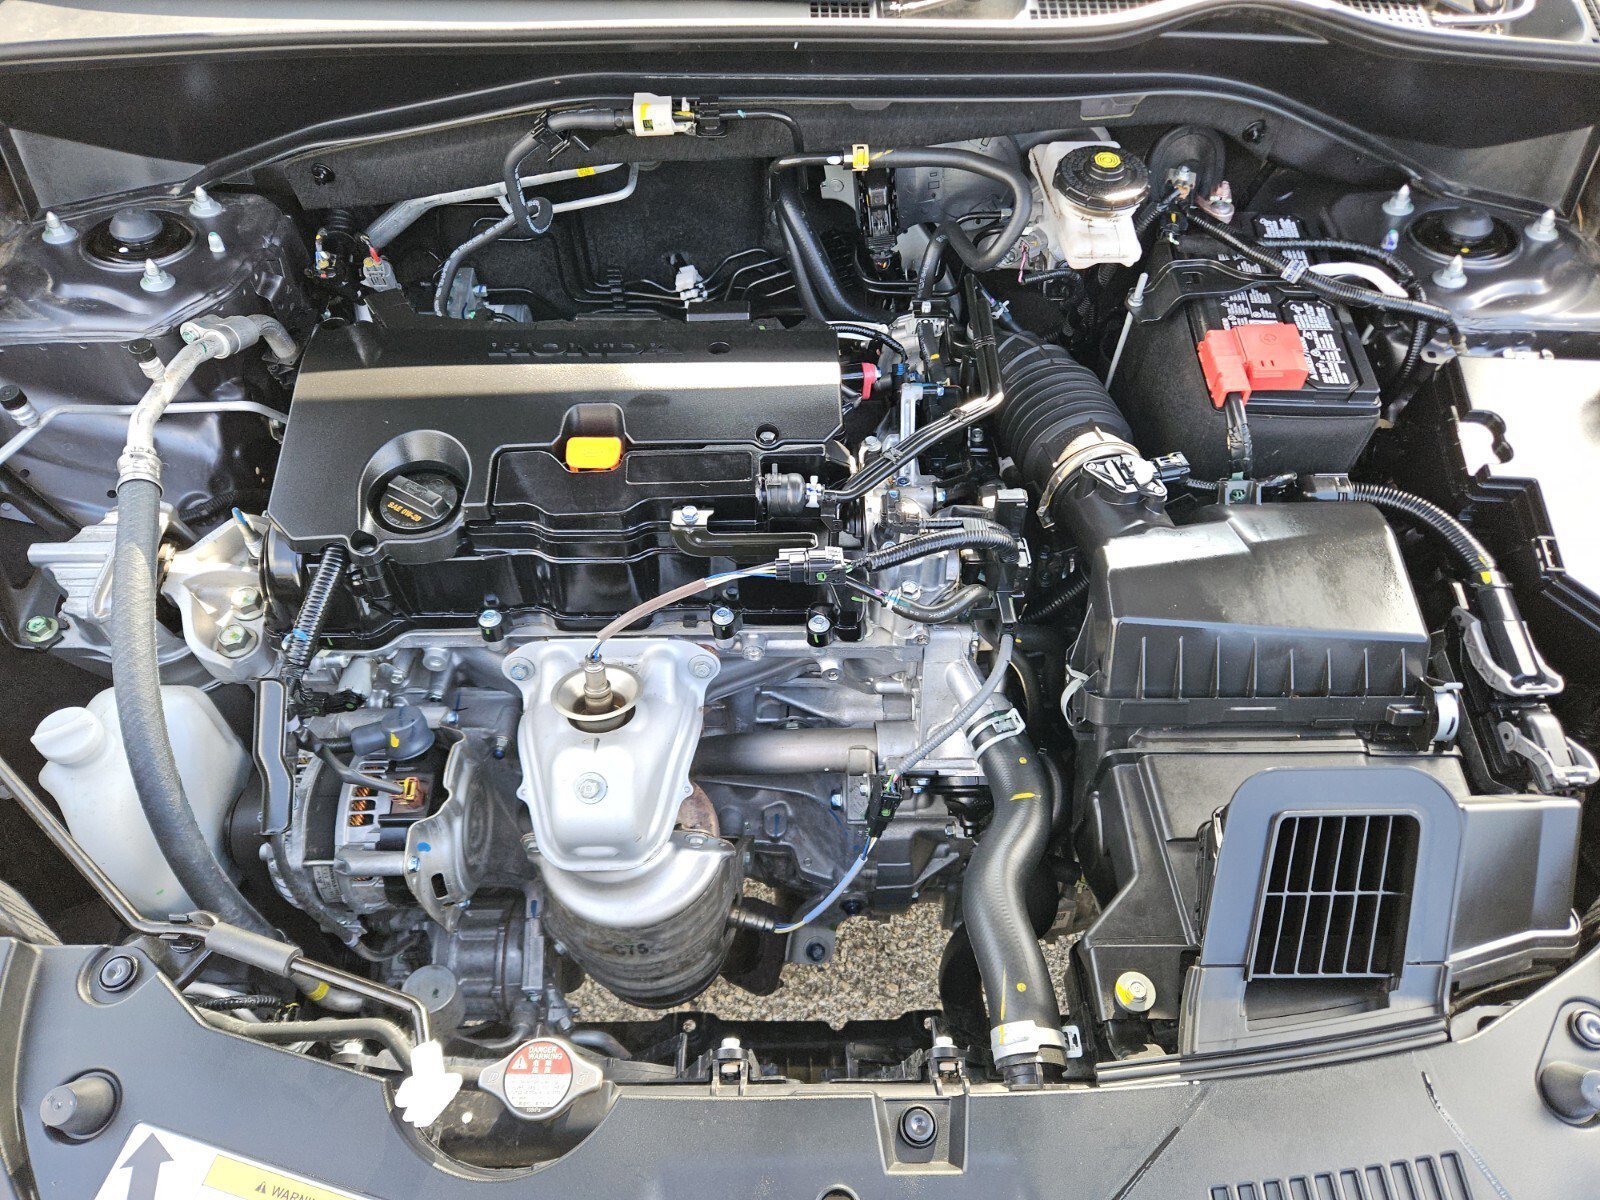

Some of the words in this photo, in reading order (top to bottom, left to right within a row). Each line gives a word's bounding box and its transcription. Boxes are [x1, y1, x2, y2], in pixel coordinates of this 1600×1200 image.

[488, 340, 683, 357] HONDA
[387, 502, 403, 512] SAE
[528, 1046, 557, 1054] DANGER
